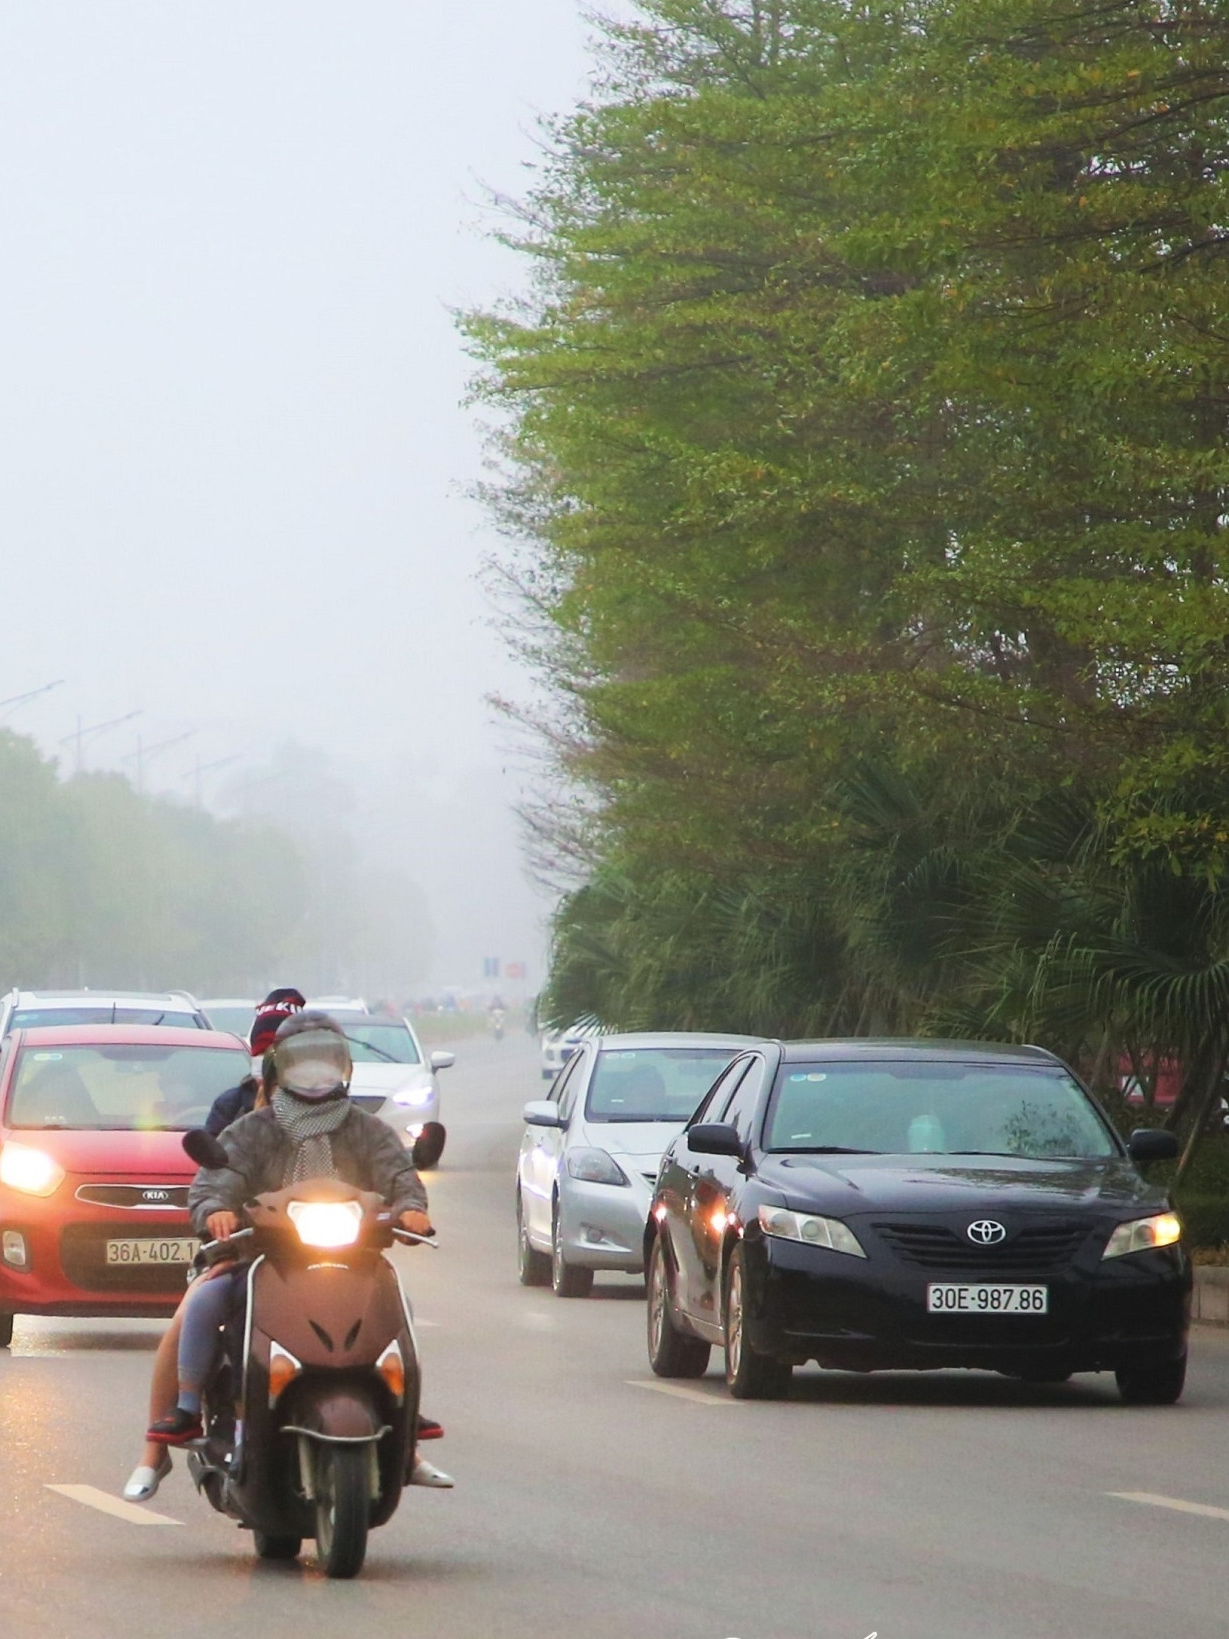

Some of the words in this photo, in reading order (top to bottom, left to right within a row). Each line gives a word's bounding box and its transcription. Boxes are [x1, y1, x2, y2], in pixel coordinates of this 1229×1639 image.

[146, 1191, 165, 1199] KIA
[109, 1242, 194, 1261] 36A-402.1
[932, 1288, 1043, 1310] 30E-987.86
